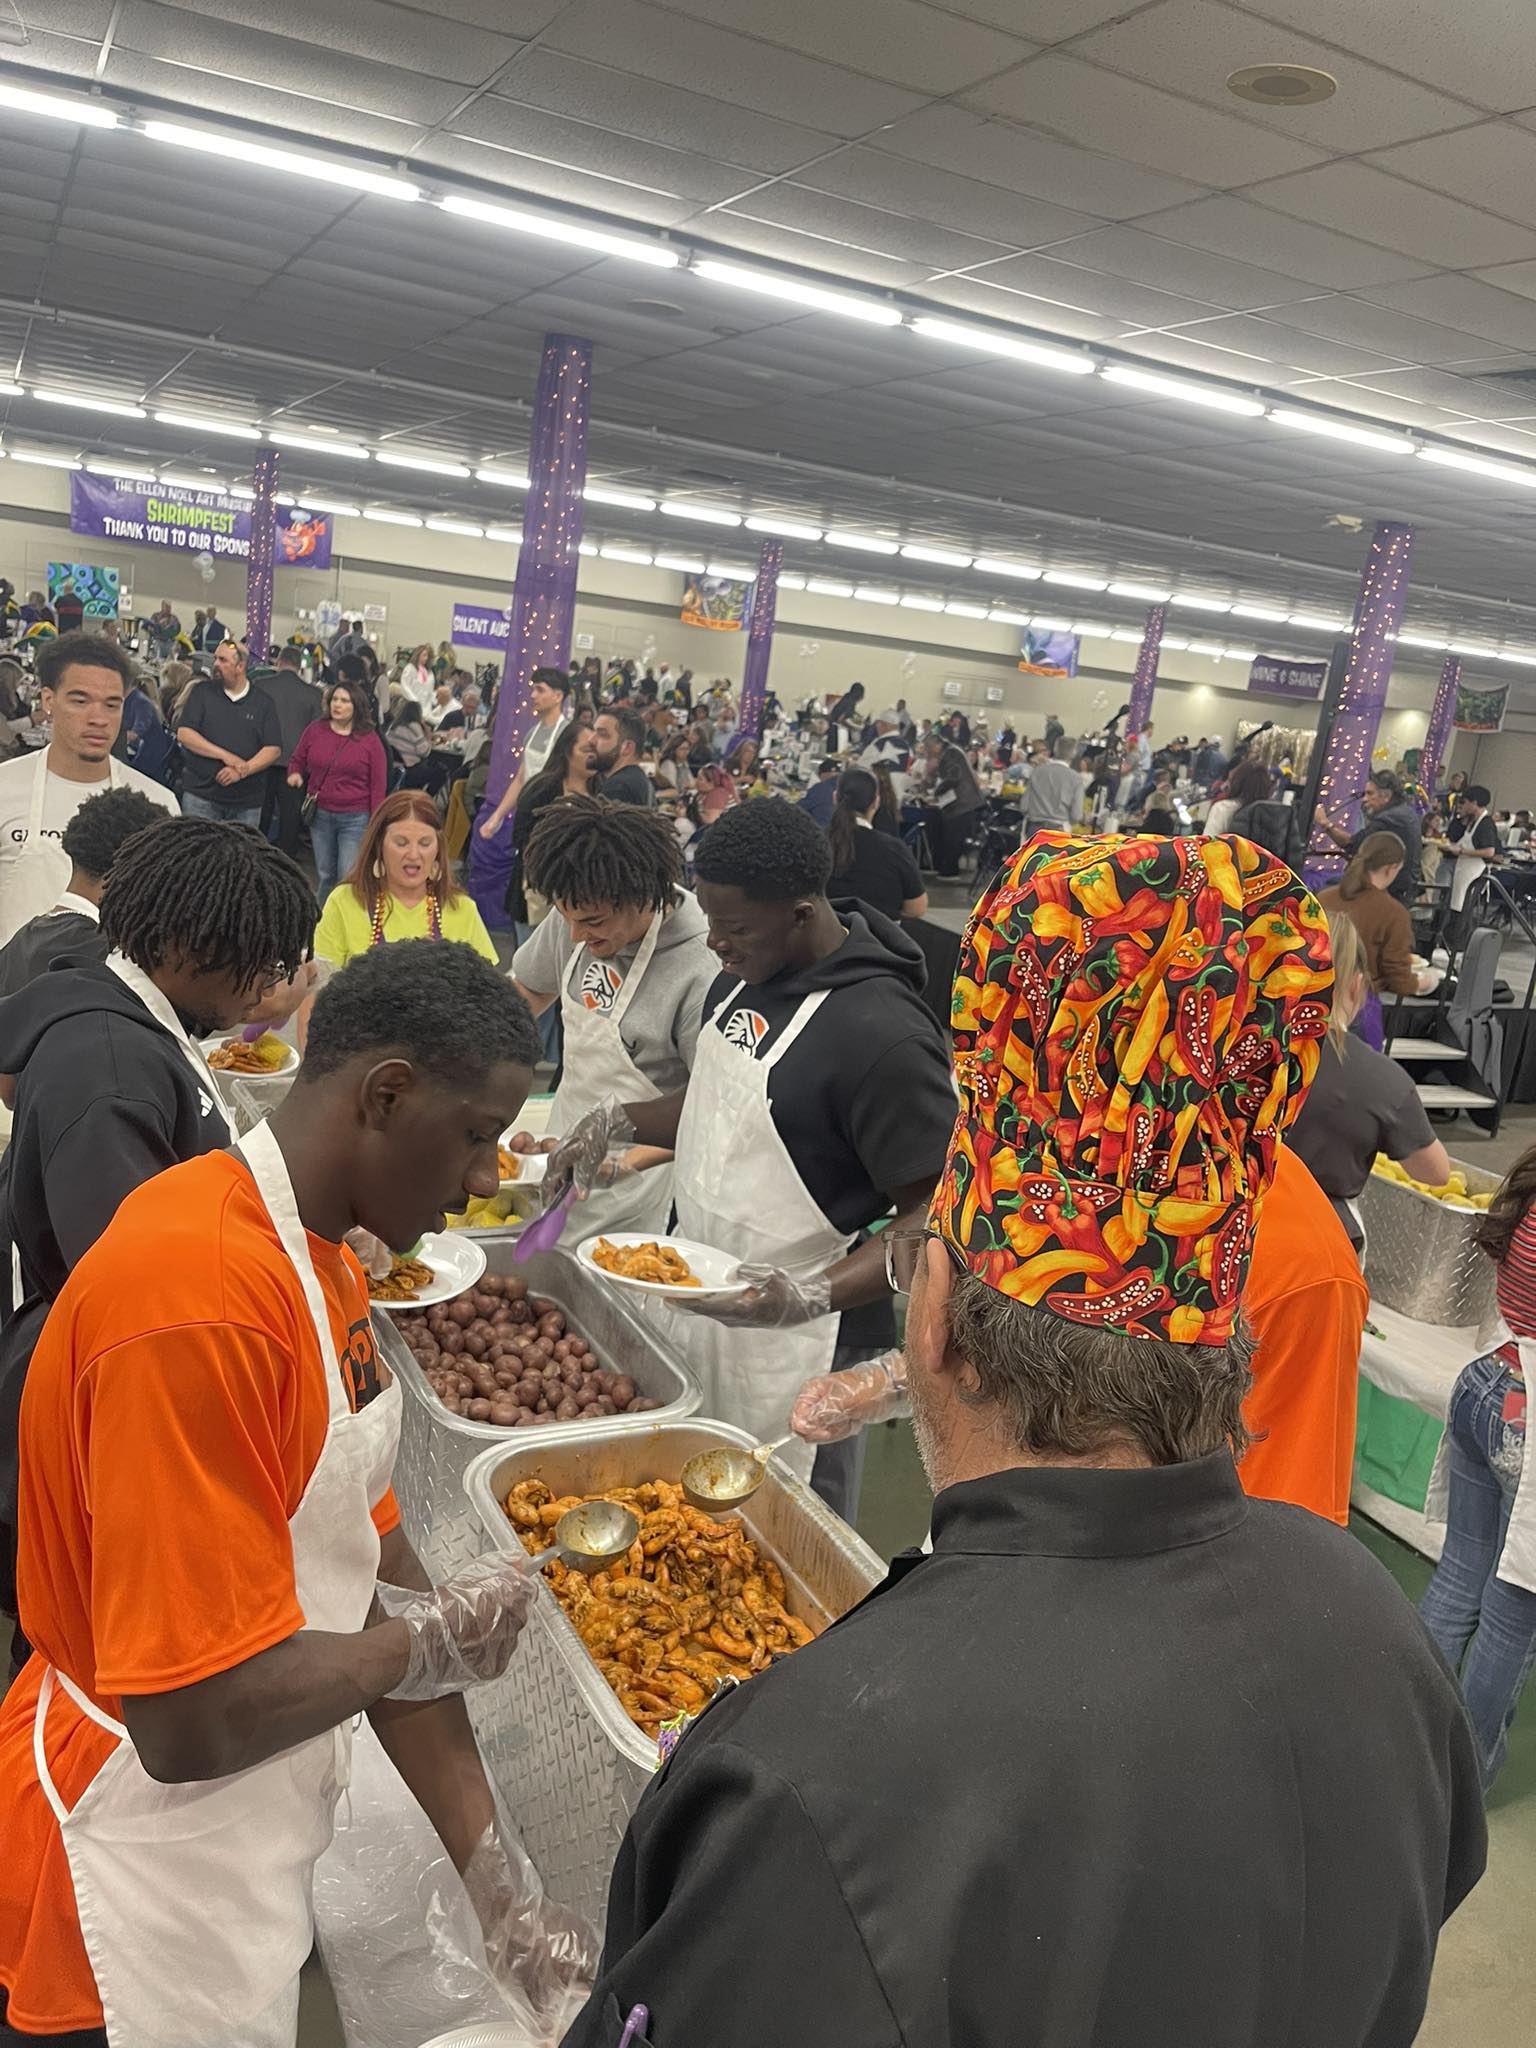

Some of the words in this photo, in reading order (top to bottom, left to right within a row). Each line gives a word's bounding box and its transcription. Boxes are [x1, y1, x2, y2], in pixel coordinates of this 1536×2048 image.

[113, 478, 134, 493] THE
[135, 481, 167, 498] ELLEN
[168, 486, 194, 503] NOEL
[195, 491, 215, 507] ART
[103, 516, 144, 539] THANK
[146, 524, 169, 544] YOU
[171, 528, 186, 546] TO
[188, 531, 211, 550] OUR
[213, 534, 251, 557] SPONS
[453, 614, 490, 635] SILENT
[1288, 670, 1322, 689] SHINE
